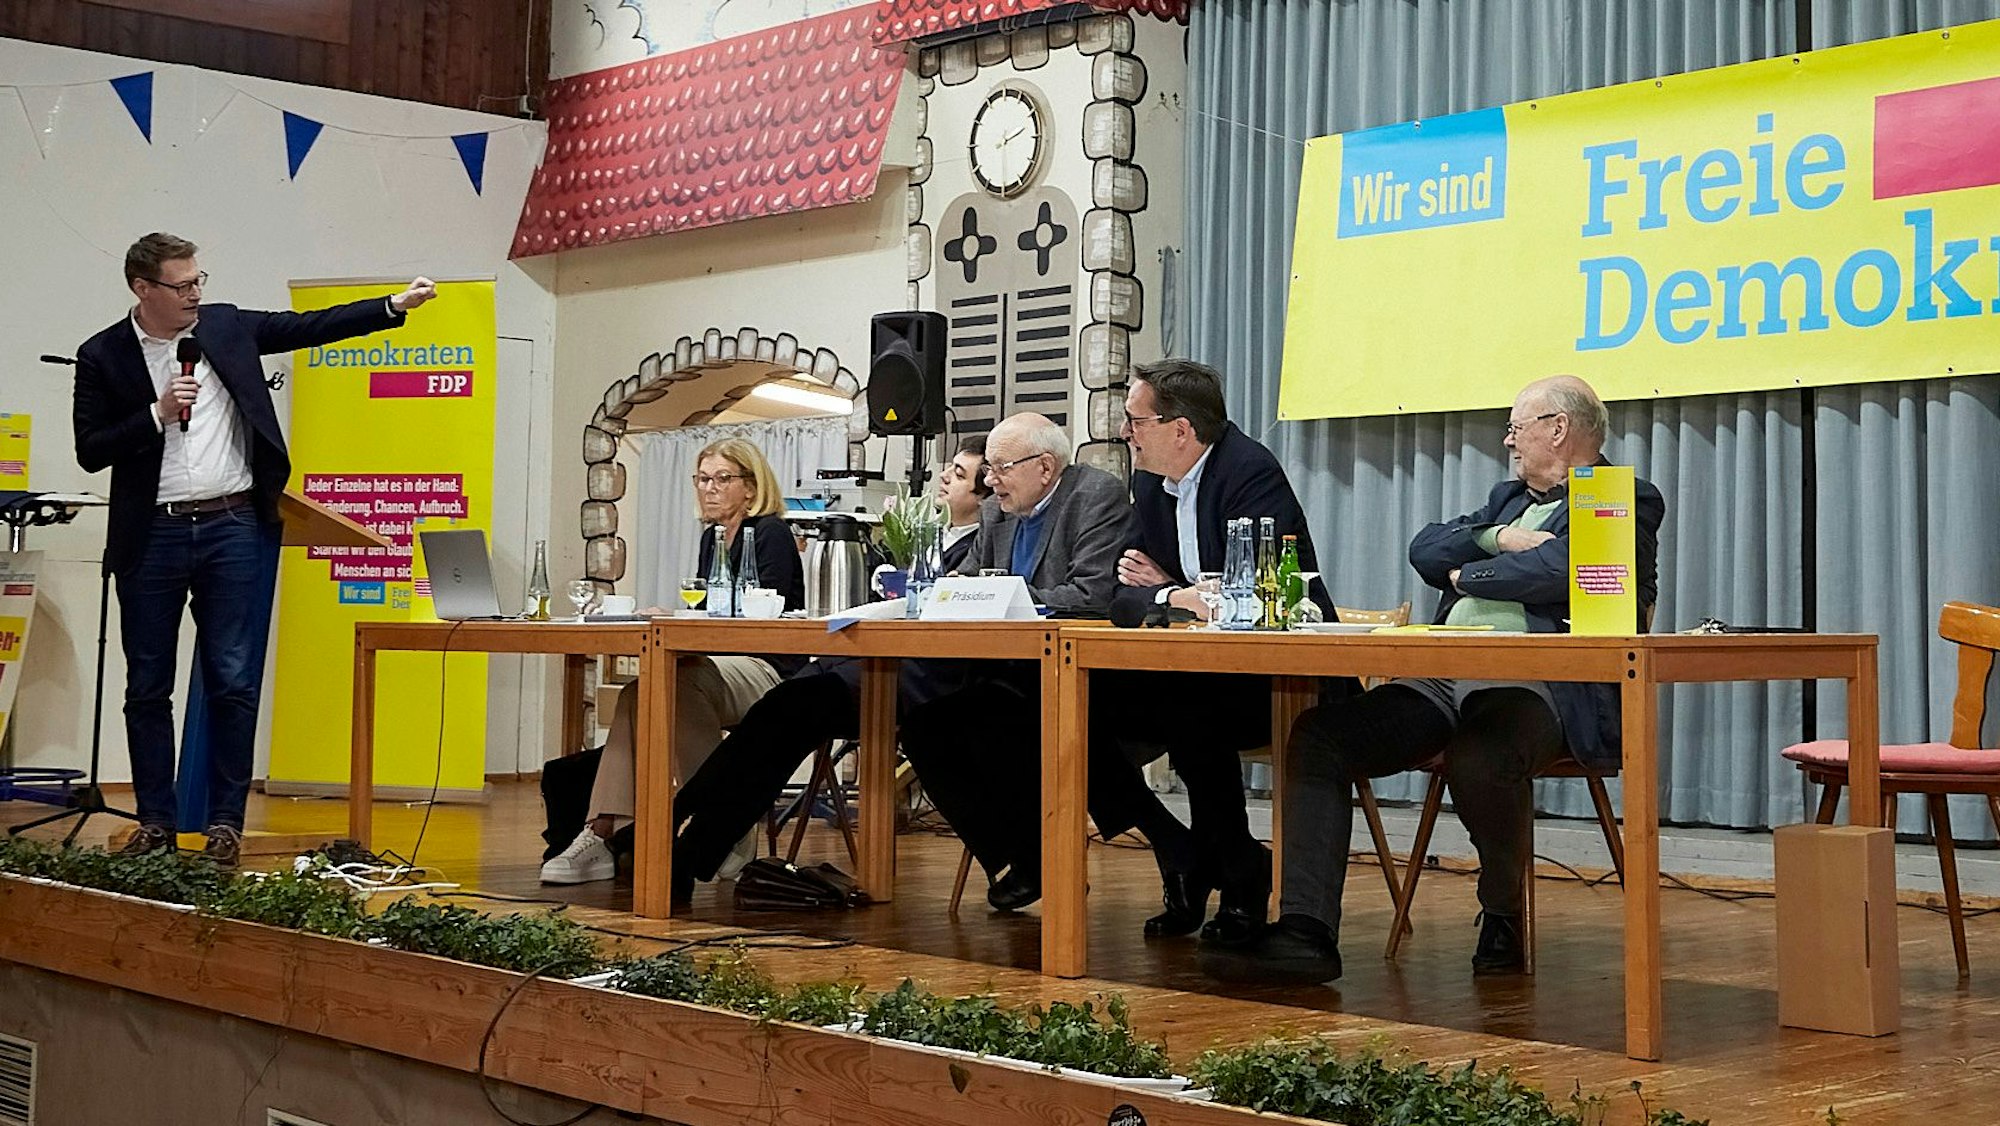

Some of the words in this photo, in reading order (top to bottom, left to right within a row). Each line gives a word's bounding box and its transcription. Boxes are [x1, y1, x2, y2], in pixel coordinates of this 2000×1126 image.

[1581, 113, 1847, 238] Freie
[1352, 170, 1411, 226] Wir
[1418, 156, 1494, 217] sind
[308, 340, 475, 368] Demokraten
[427, 375, 468, 394] FDP
[305, 477, 333, 493] Jeder
[334, 477, 372, 493] Einzelne
[373, 478, 389, 493] hat
[390, 481, 402, 493] es
[403, 478, 414, 493] in
[415, 478, 431, 493] der
[374, 499, 418, 514] Chancen.
[419, 499, 464, 514] Aufbruch.
[379, 521, 405, 535] dabei
[334, 563, 381, 578] Menschen
[382, 567, 396, 578] an
[396, 563, 412, 577] sic
[343, 586, 360, 599] Wir
[361, 586, 381, 600] sind
[950, 591, 996, 601] Präsidium
